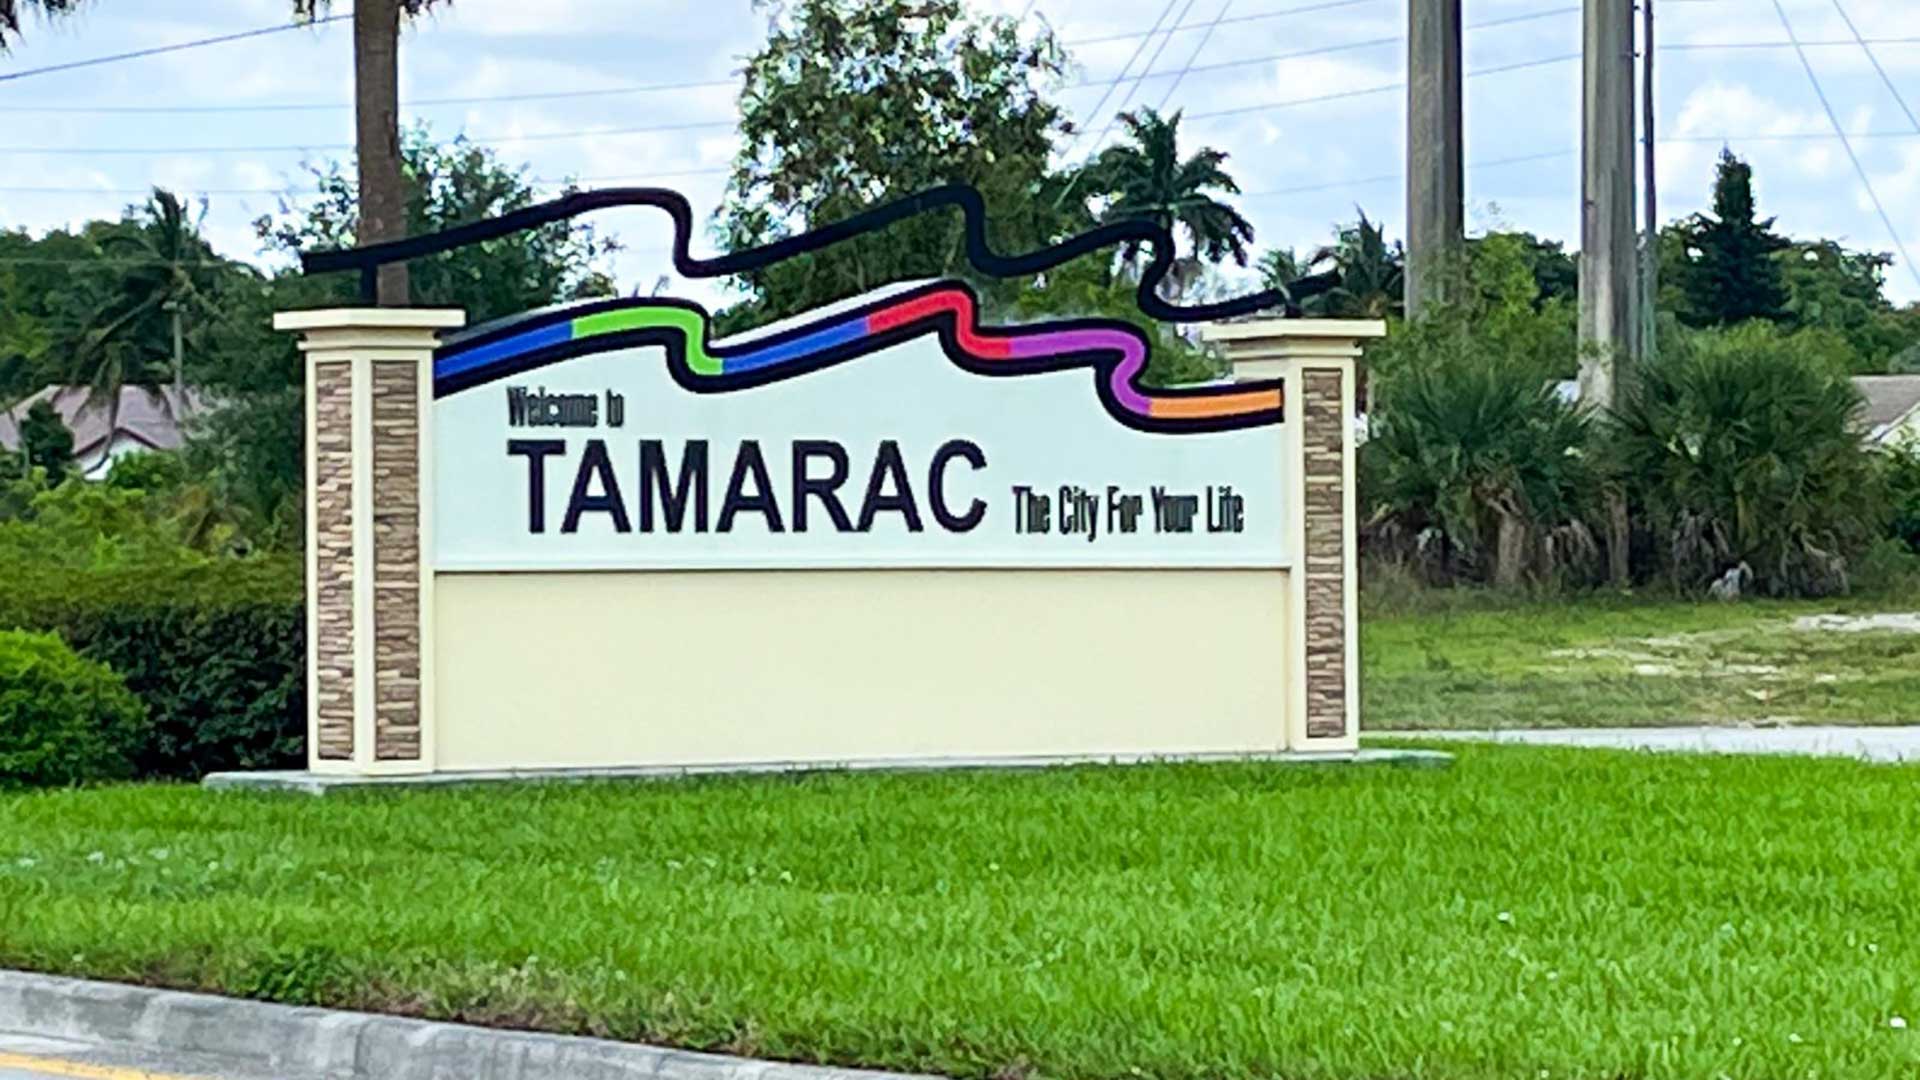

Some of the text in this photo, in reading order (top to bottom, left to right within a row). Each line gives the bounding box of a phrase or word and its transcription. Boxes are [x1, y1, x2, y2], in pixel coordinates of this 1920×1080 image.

[507, 387, 624, 428] Welcome to
[507, 439, 988, 534] TAMARAC
[1012, 486, 1244, 543] The City For Your Life
